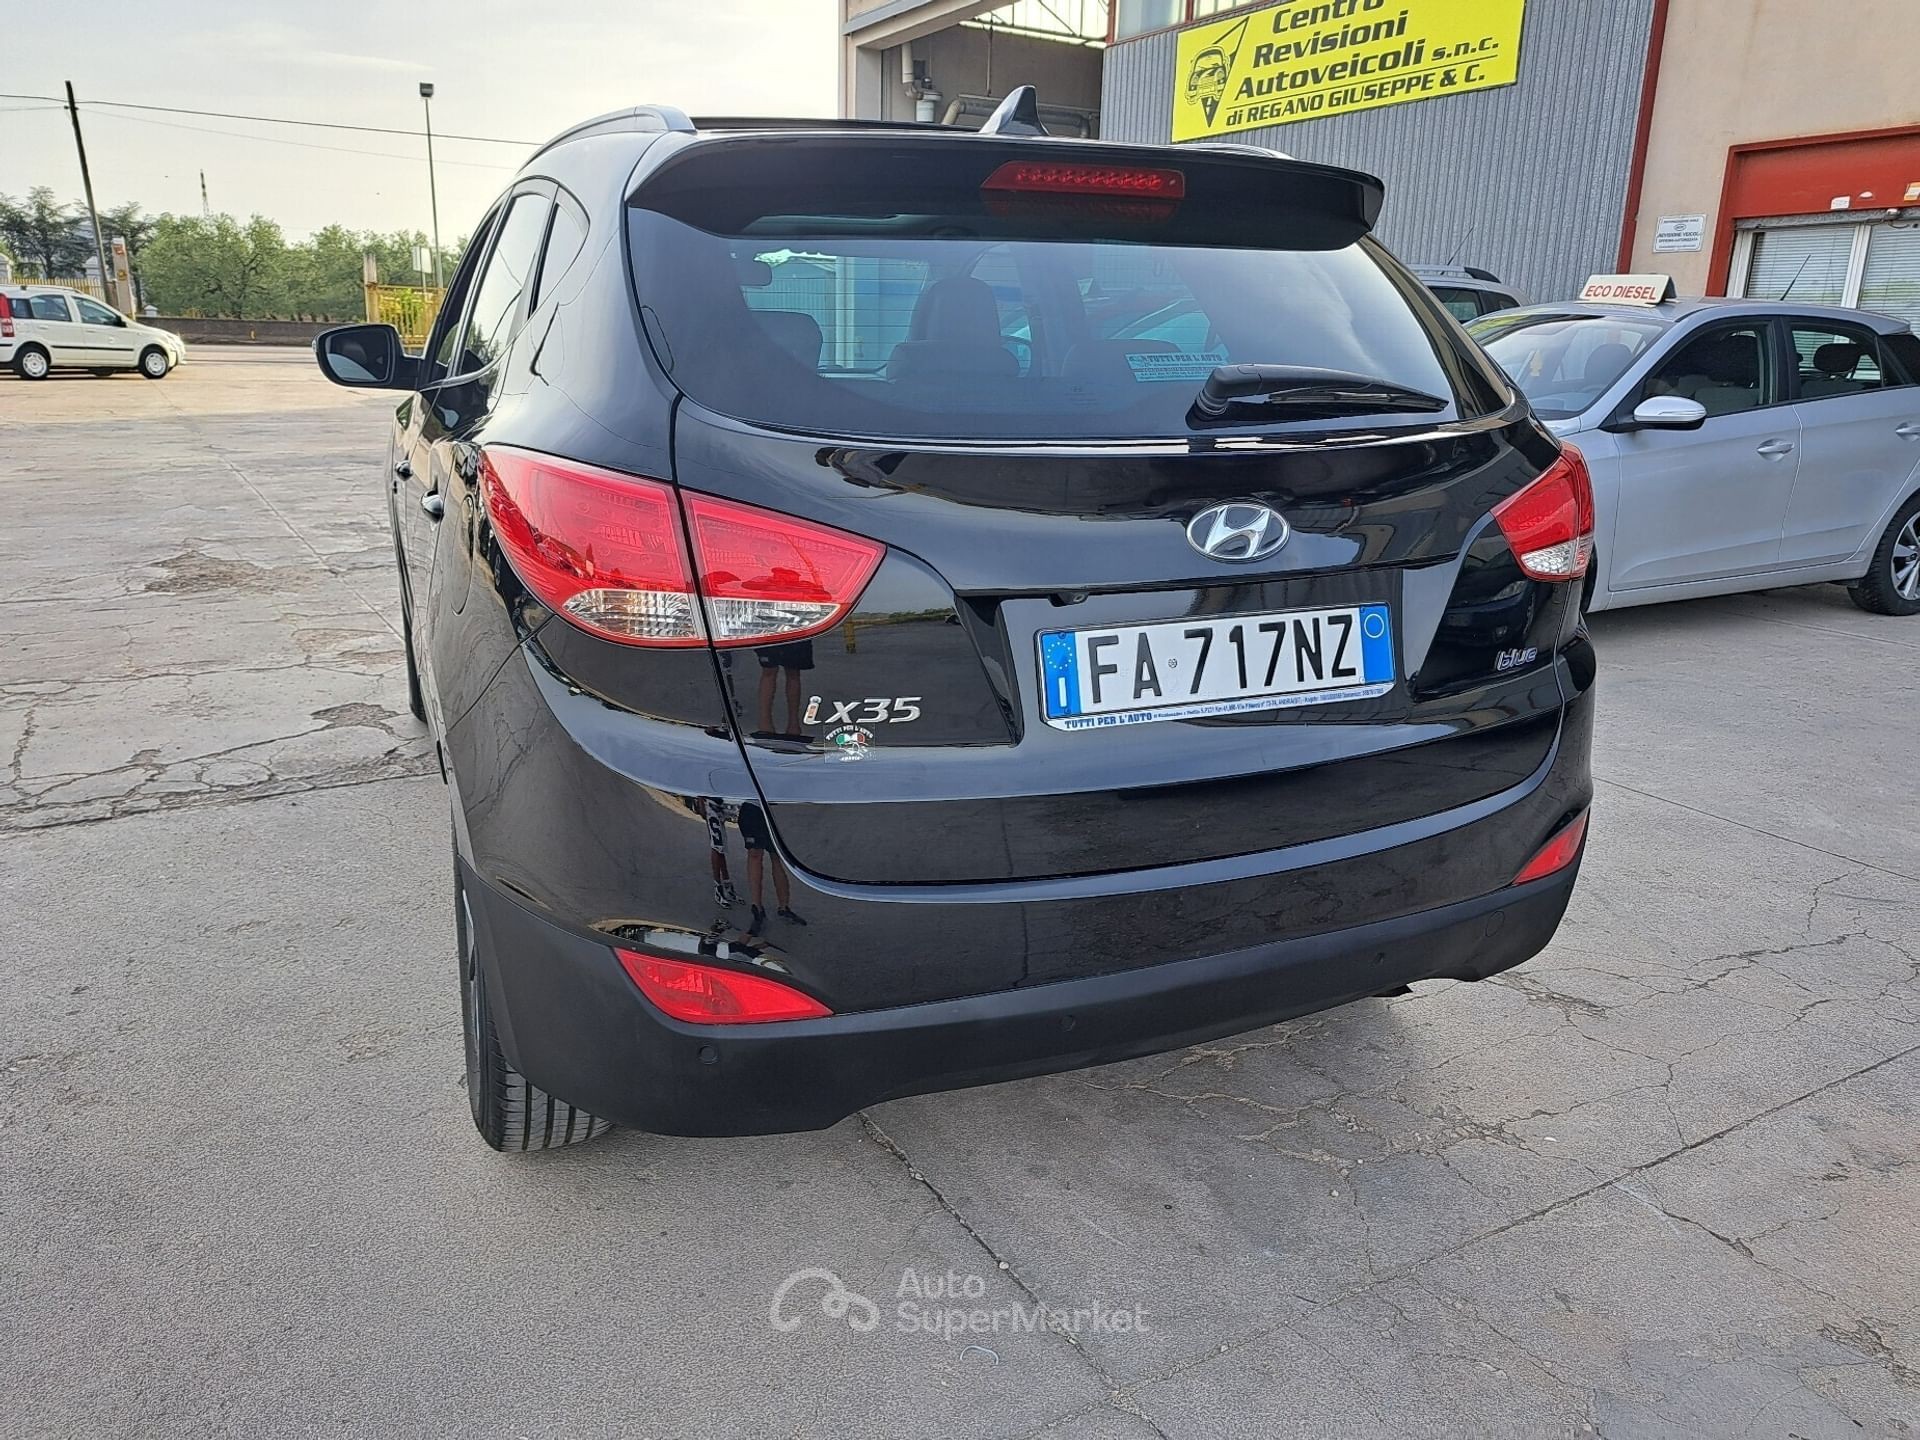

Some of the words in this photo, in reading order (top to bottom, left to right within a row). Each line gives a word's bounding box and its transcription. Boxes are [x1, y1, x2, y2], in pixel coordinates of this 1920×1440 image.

[1252, 10, 1409, 68] Revisioni
[1272, 0, 1385, 34] Centro
[1235, 39, 1426, 101] Autoveicoli
[1431, 37, 1499, 62] s.n.c.
[1226, 110, 1243, 127] di
[1246, 94, 1323, 123] REGANO
[1329, 73, 1434, 108] GIUSEPPE
[1439, 69, 1457, 87] &
[1464, 64, 1485, 82] C.
[1585, 285, 1612, 297] ECO
[1613, 285, 1657, 300] DIESEL
[1087, 631, 1162, 704] FA
[1184, 614, 1357, 695] 717NZ
[803, 695, 922, 725] ix35
[1064, 717, 1095, 729] TUTTI
[1097, 715, 1116, 726] PER
[1119, 712, 1152, 724] L'AUTO
